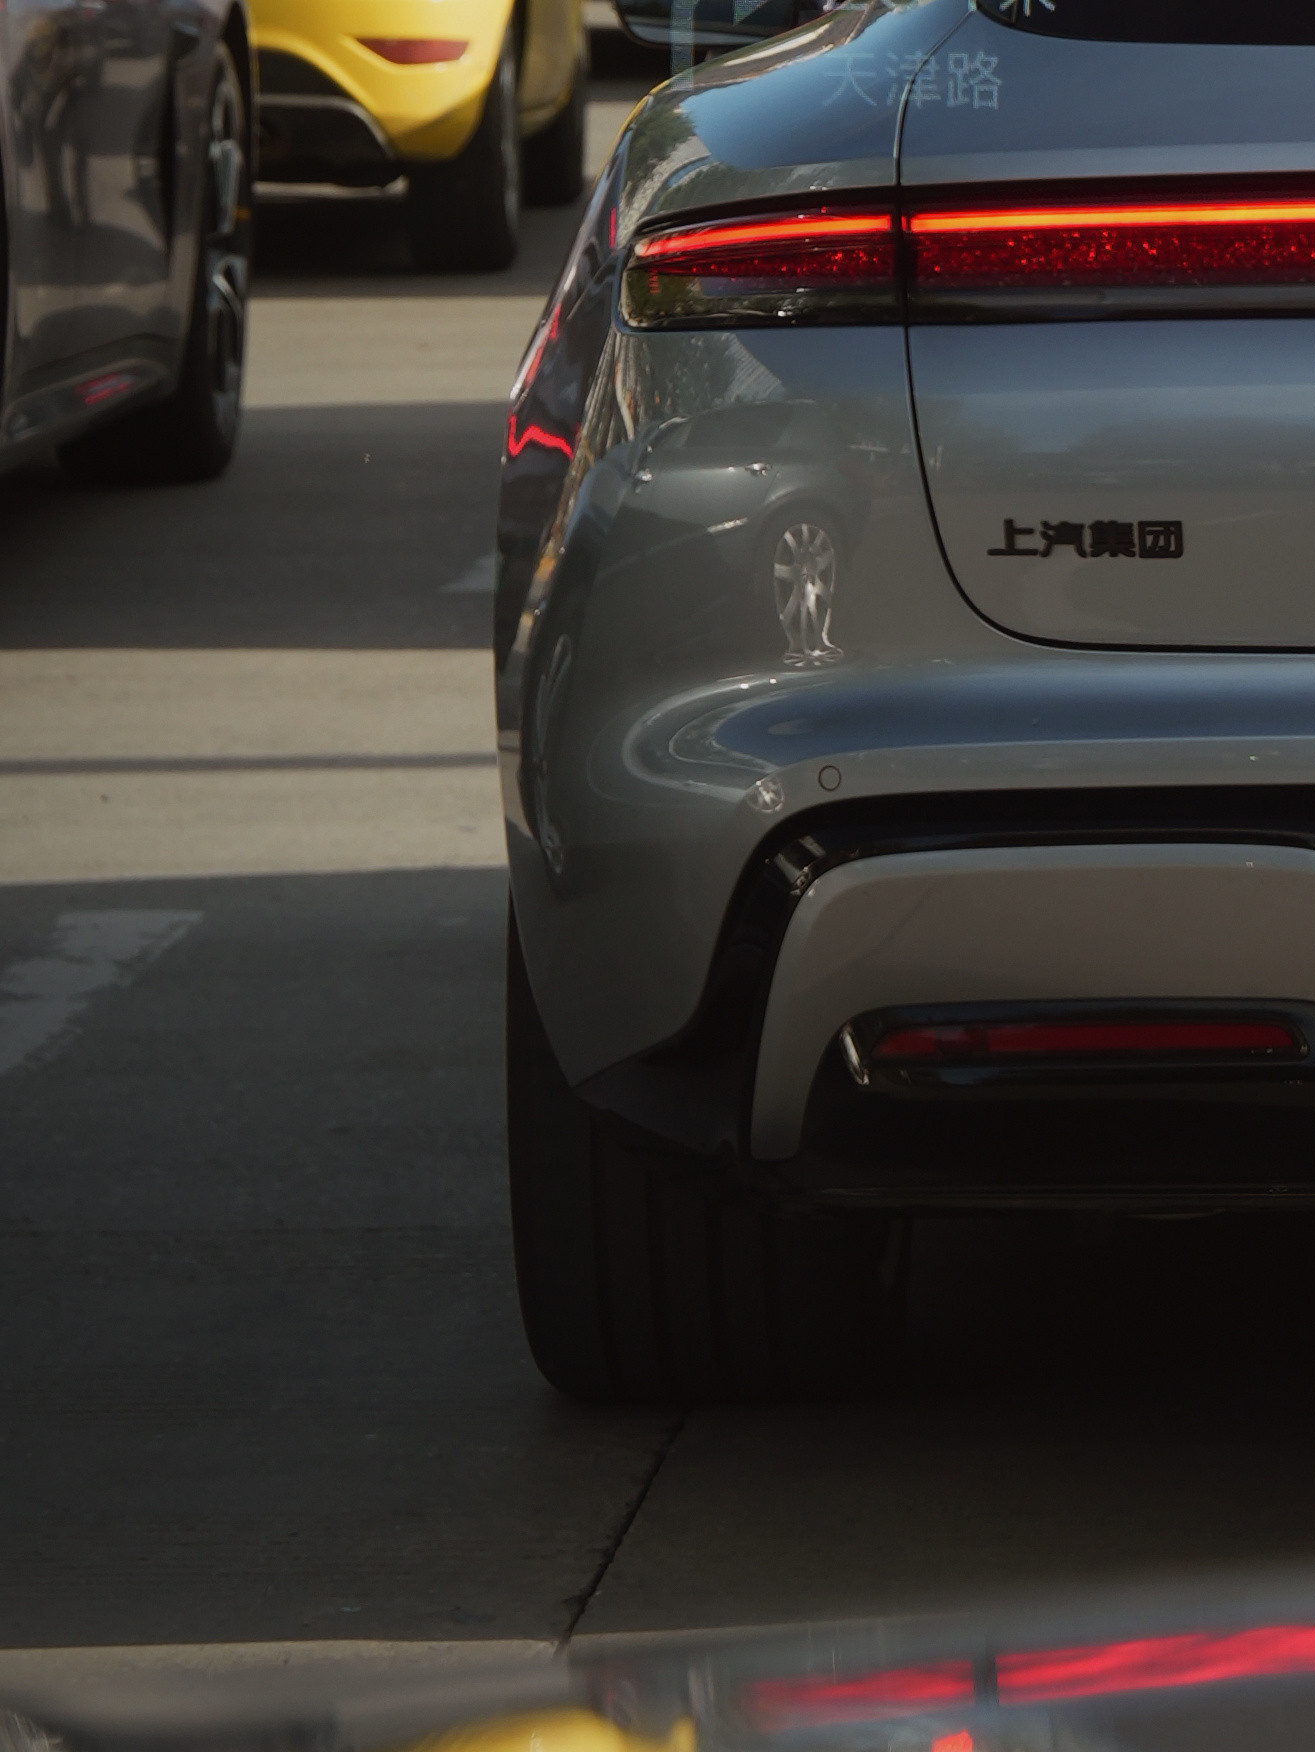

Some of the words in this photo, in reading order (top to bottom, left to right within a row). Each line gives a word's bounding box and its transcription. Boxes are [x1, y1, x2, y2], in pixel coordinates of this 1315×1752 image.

[822, 50, 1002, 110] 天津路
[986, 517, 1184, 560] 上汽集团
